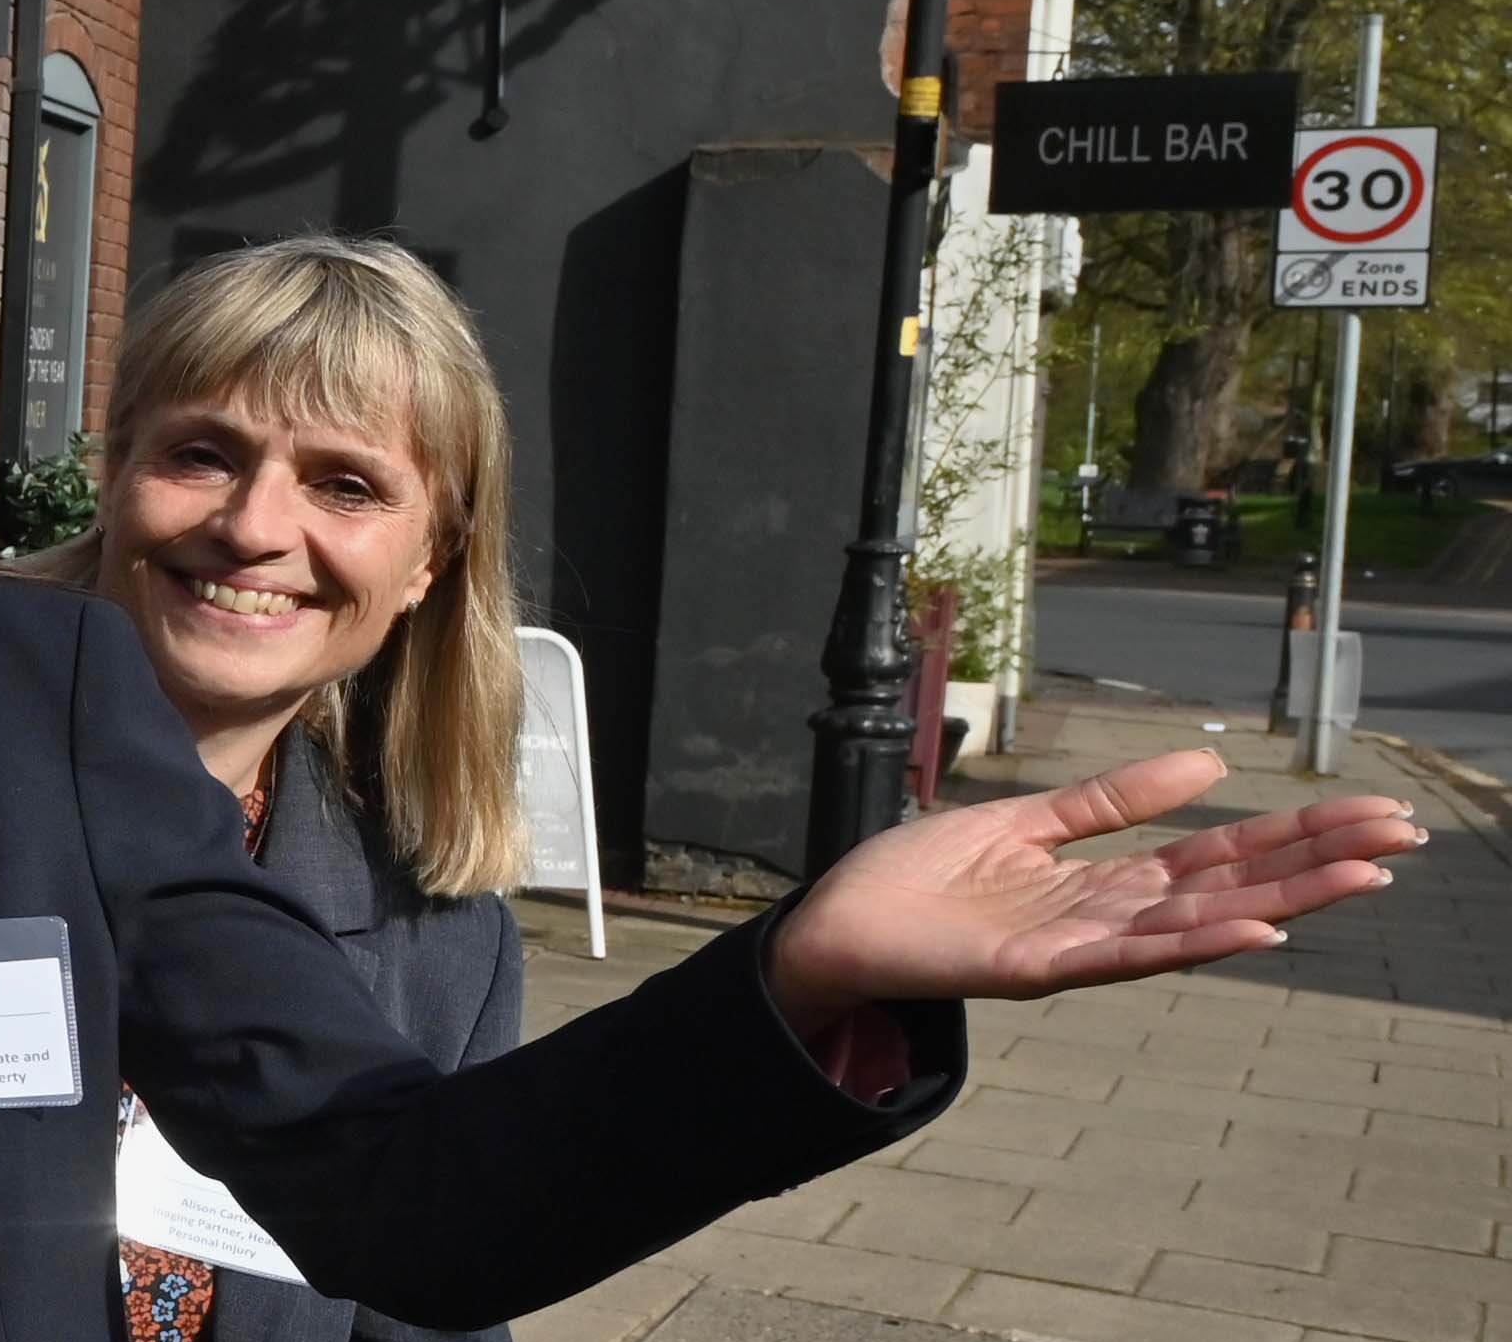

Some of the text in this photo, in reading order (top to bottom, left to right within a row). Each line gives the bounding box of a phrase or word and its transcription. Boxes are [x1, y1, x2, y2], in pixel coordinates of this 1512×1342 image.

[1038, 121, 1249, 165] CHILL BAR
[1311, 168, 1405, 212] 30
[1356, 261, 1406, 275] Zone
[1341, 278, 1419, 298] ENDS
[23, 1050, 50, 1062] and
[181, 1197, 217, 1216] Alison
[168, 1226, 257, 1260] Personal Injury
